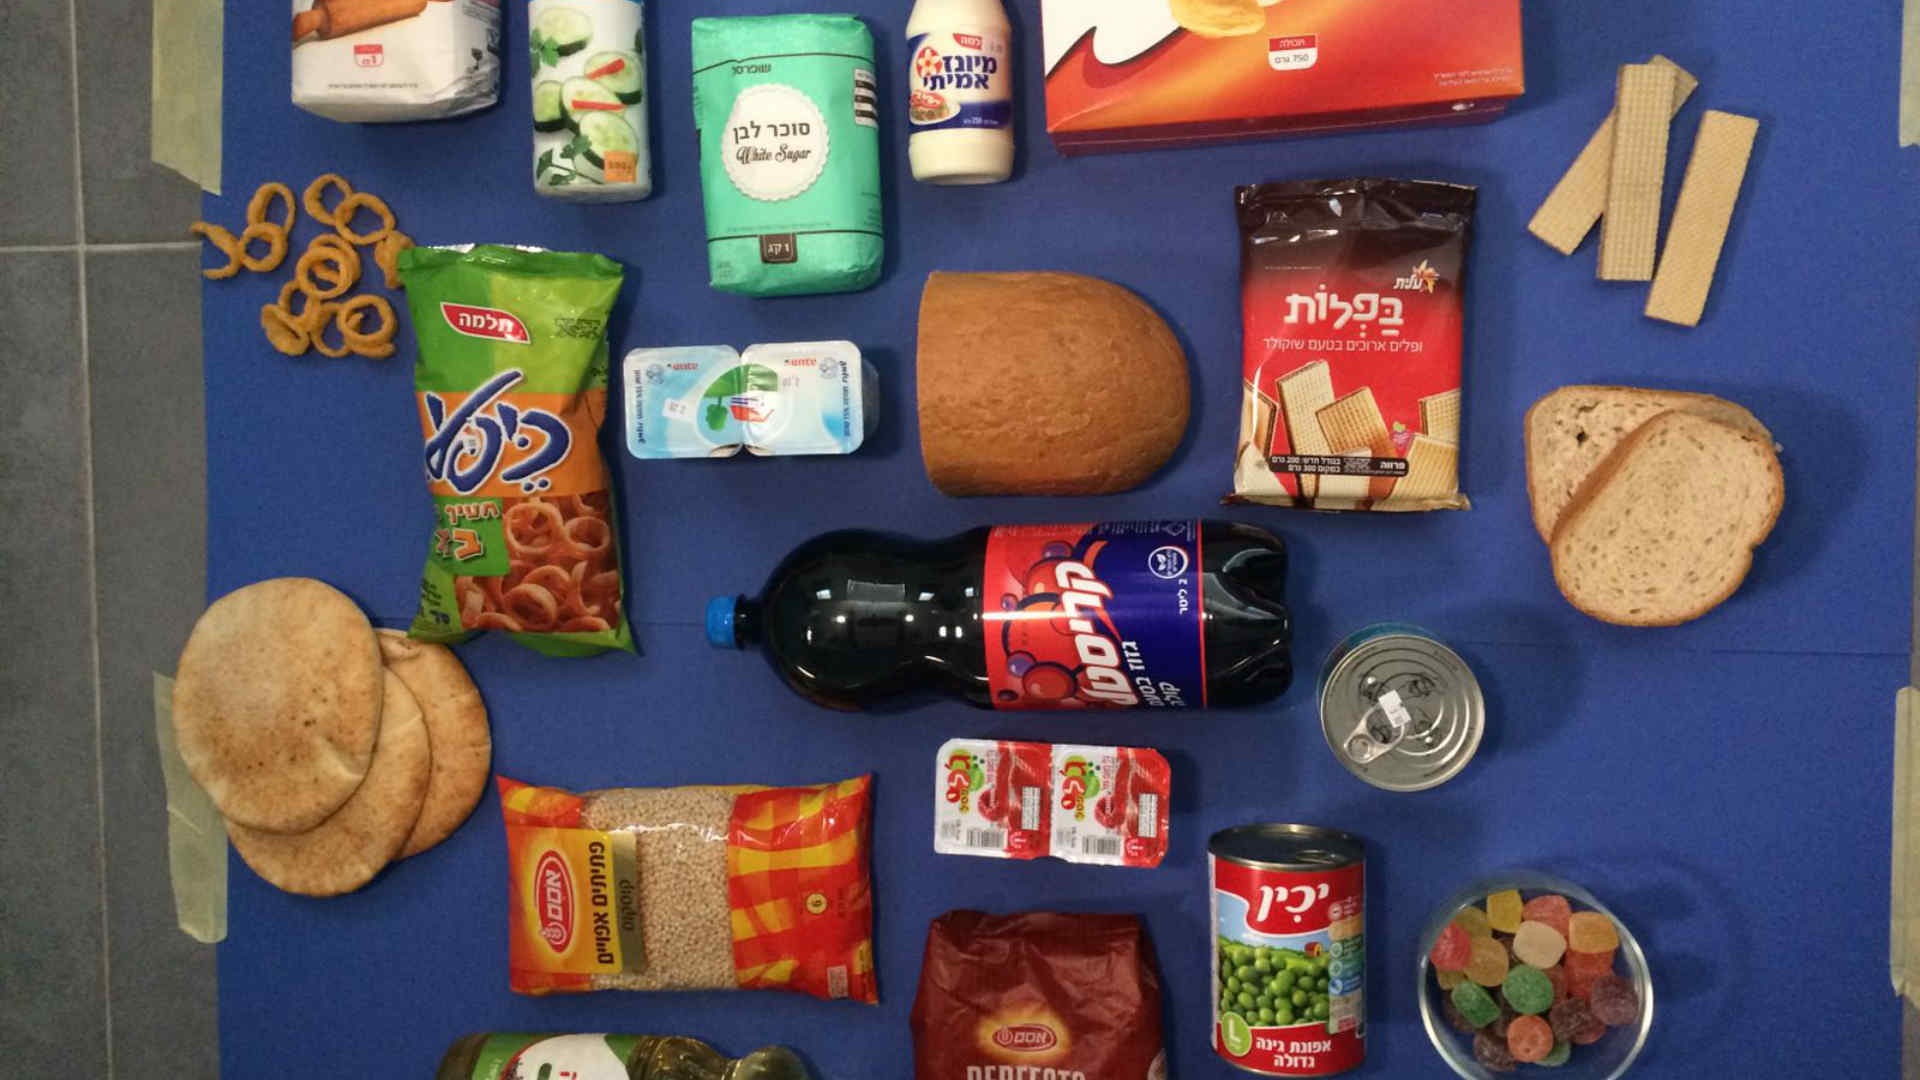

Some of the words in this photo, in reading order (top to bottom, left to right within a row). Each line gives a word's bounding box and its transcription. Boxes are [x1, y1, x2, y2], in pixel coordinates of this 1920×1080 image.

[942, 56, 998, 74] מיונז
[1274, 56, 1290, 64] גרם
[732, 64, 772, 77] שופרסל
[922, 73, 990, 91] אמיתי
[732, 120, 762, 145] לבן
[766, 122, 811, 138] סוכר
[736, 146, 773, 165] White
[774, 143, 812, 164] Sugar
[1393, 275, 1424, 290] עלית
[458, 311, 514, 333] תלמה
[1264, 337, 1305, 353] שוקולד
[1308, 339, 1344, 351] בטעם
[1346, 340, 1386, 352] ארוכים
[1390, 338, 1423, 353] ופלים
[1287, 464, 1301, 472] גרם
[1380, 461, 1406, 470] פרווה
[444, 501, 500, 525] חטיף
[1177, 589, 1189, 615] ליטר
[1054, 560, 1139, 706] קריסטל
[1122, 640, 1146, 671] גזוז
[1134, 676, 1163, 707] בטעם
[1158, 681, 1188, 707] קולה
[588, 841, 608, 906] פתיתים
[545, 869, 563, 921] אסם
[1256, 883, 1331, 924] יכין
[618, 879, 637, 932] קוסקוס
[592, 911, 615, 965] אפויים
[1013, 1032, 1047, 1044] אסם
[1228, 1018, 1242, 1043] L
[1255, 1036, 1285, 1053] גינה
[1289, 1039, 1332, 1054] אפונת
[1272, 1053, 1315, 1069] גדולה
